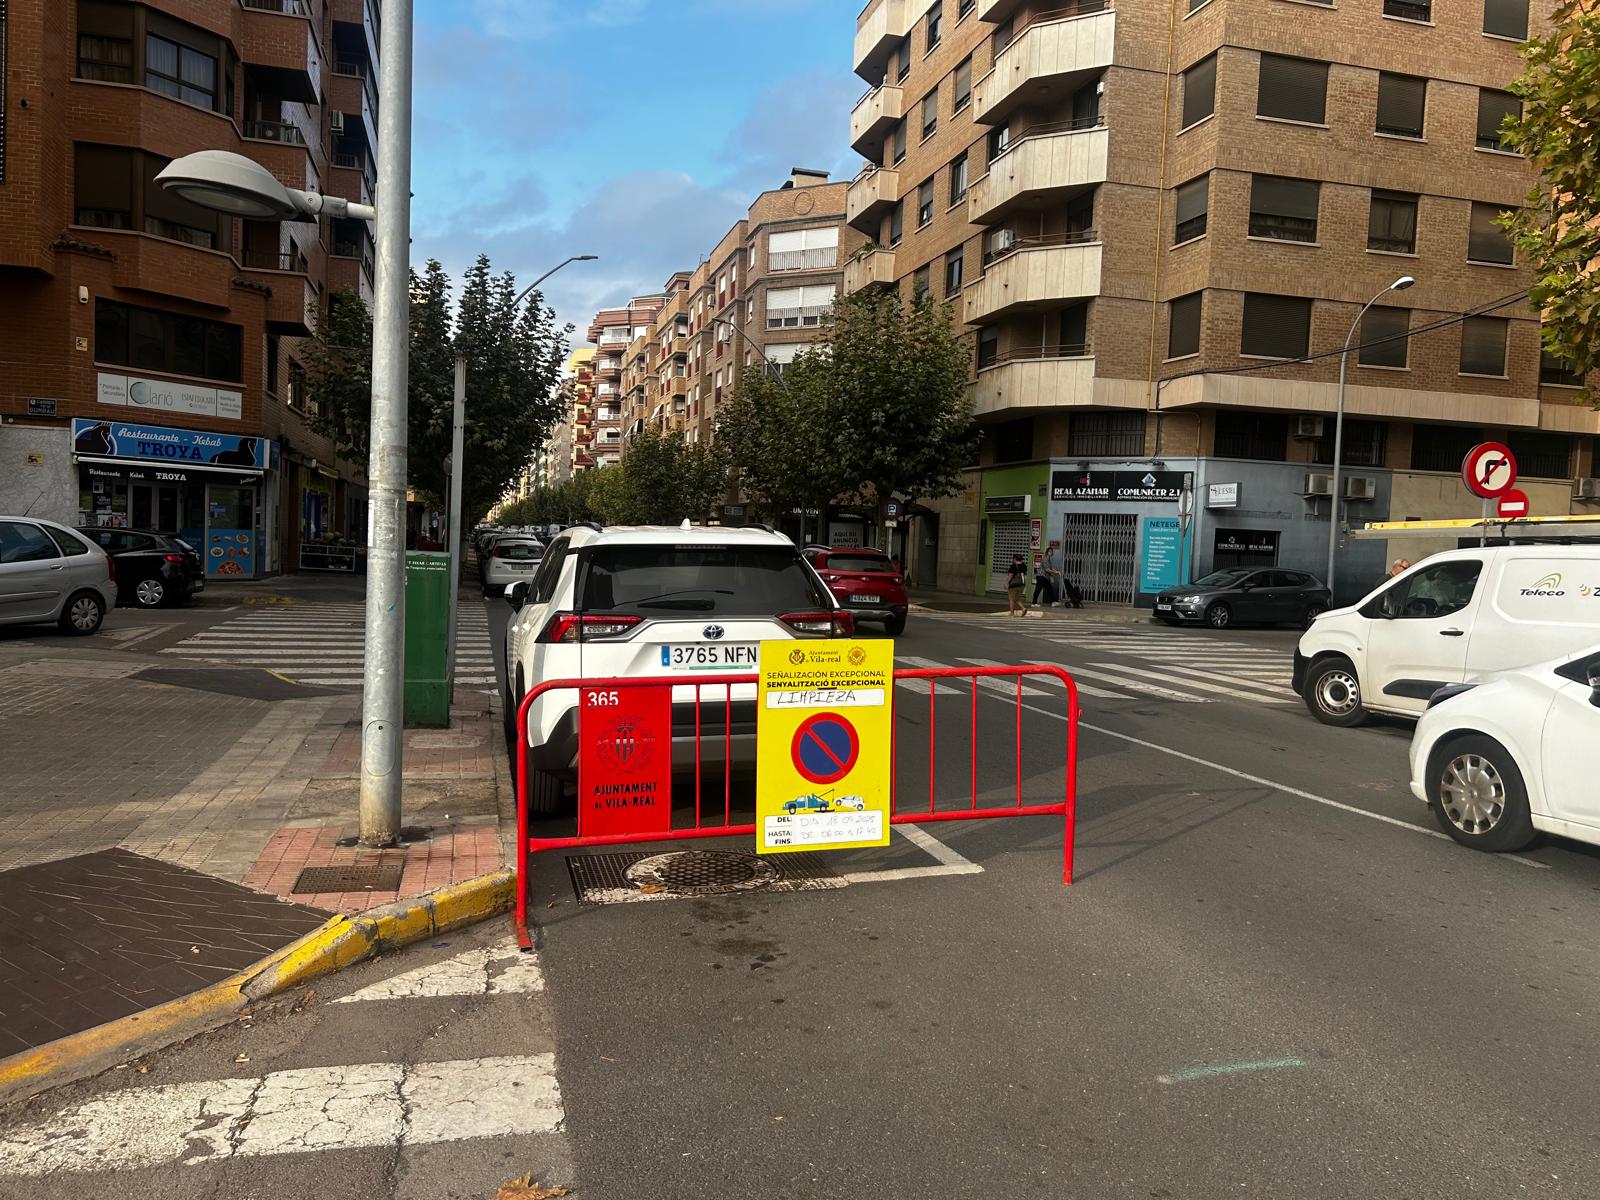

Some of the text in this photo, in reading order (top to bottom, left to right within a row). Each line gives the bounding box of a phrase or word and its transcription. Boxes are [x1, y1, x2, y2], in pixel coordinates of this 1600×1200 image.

[118, 428, 180, 442] Restaurante
[192, 435, 222, 447] Kebab
[137, 442, 204, 460] TROYA
[156, 472, 187, 481] TROYA
[1075, 488, 1110, 496] AZAHAR
[1118, 488, 1180, 496] COMUNICER 2.1
[674, 646, 757, 664] 3765 NFN
[767, 671, 828, 679] SEÑALIZACIÓN
[766, 679, 828, 688] SENYALITZACIÓ
[588, 692, 619, 707] 365
[778, 690, 856, 704] LIMPIEZA
[594, 782, 657, 795] AJUNTAMENT
